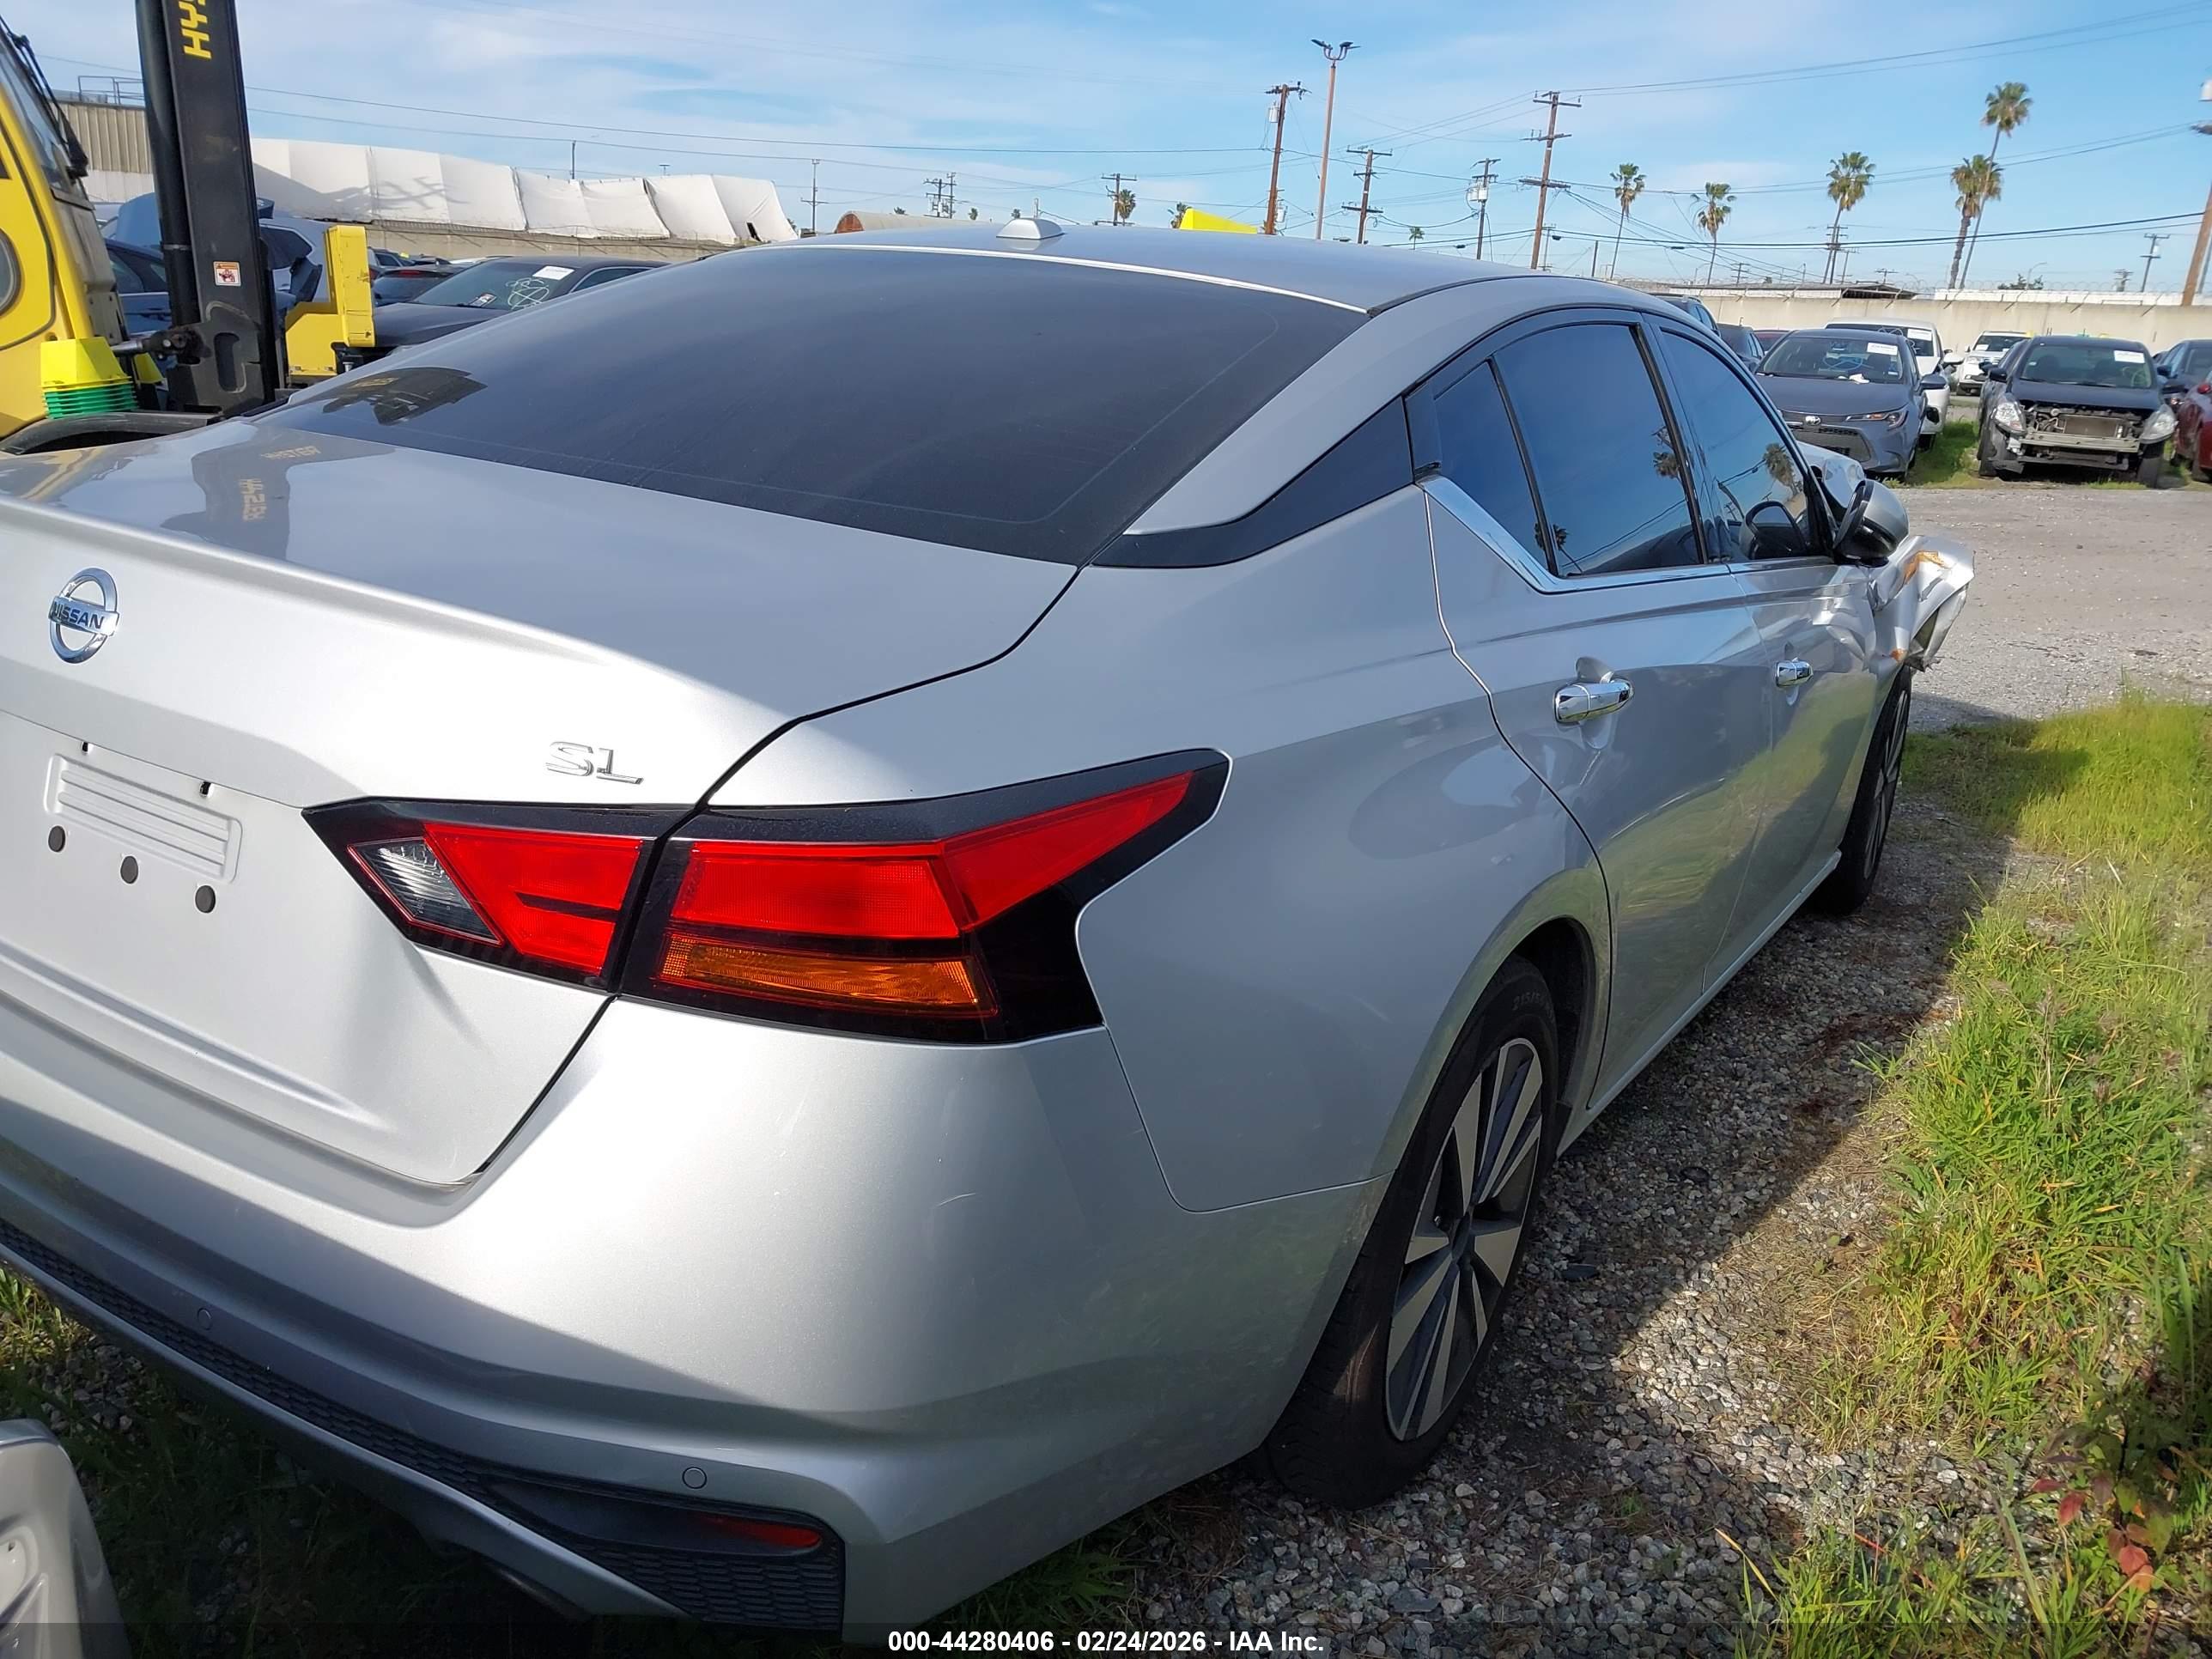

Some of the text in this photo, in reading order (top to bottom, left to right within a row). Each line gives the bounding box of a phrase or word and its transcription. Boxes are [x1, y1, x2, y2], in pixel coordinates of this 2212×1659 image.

[178, 0, 212, 59] HY
[53, 601, 105, 629] NISSAN
[544, 740, 645, 786] SL
